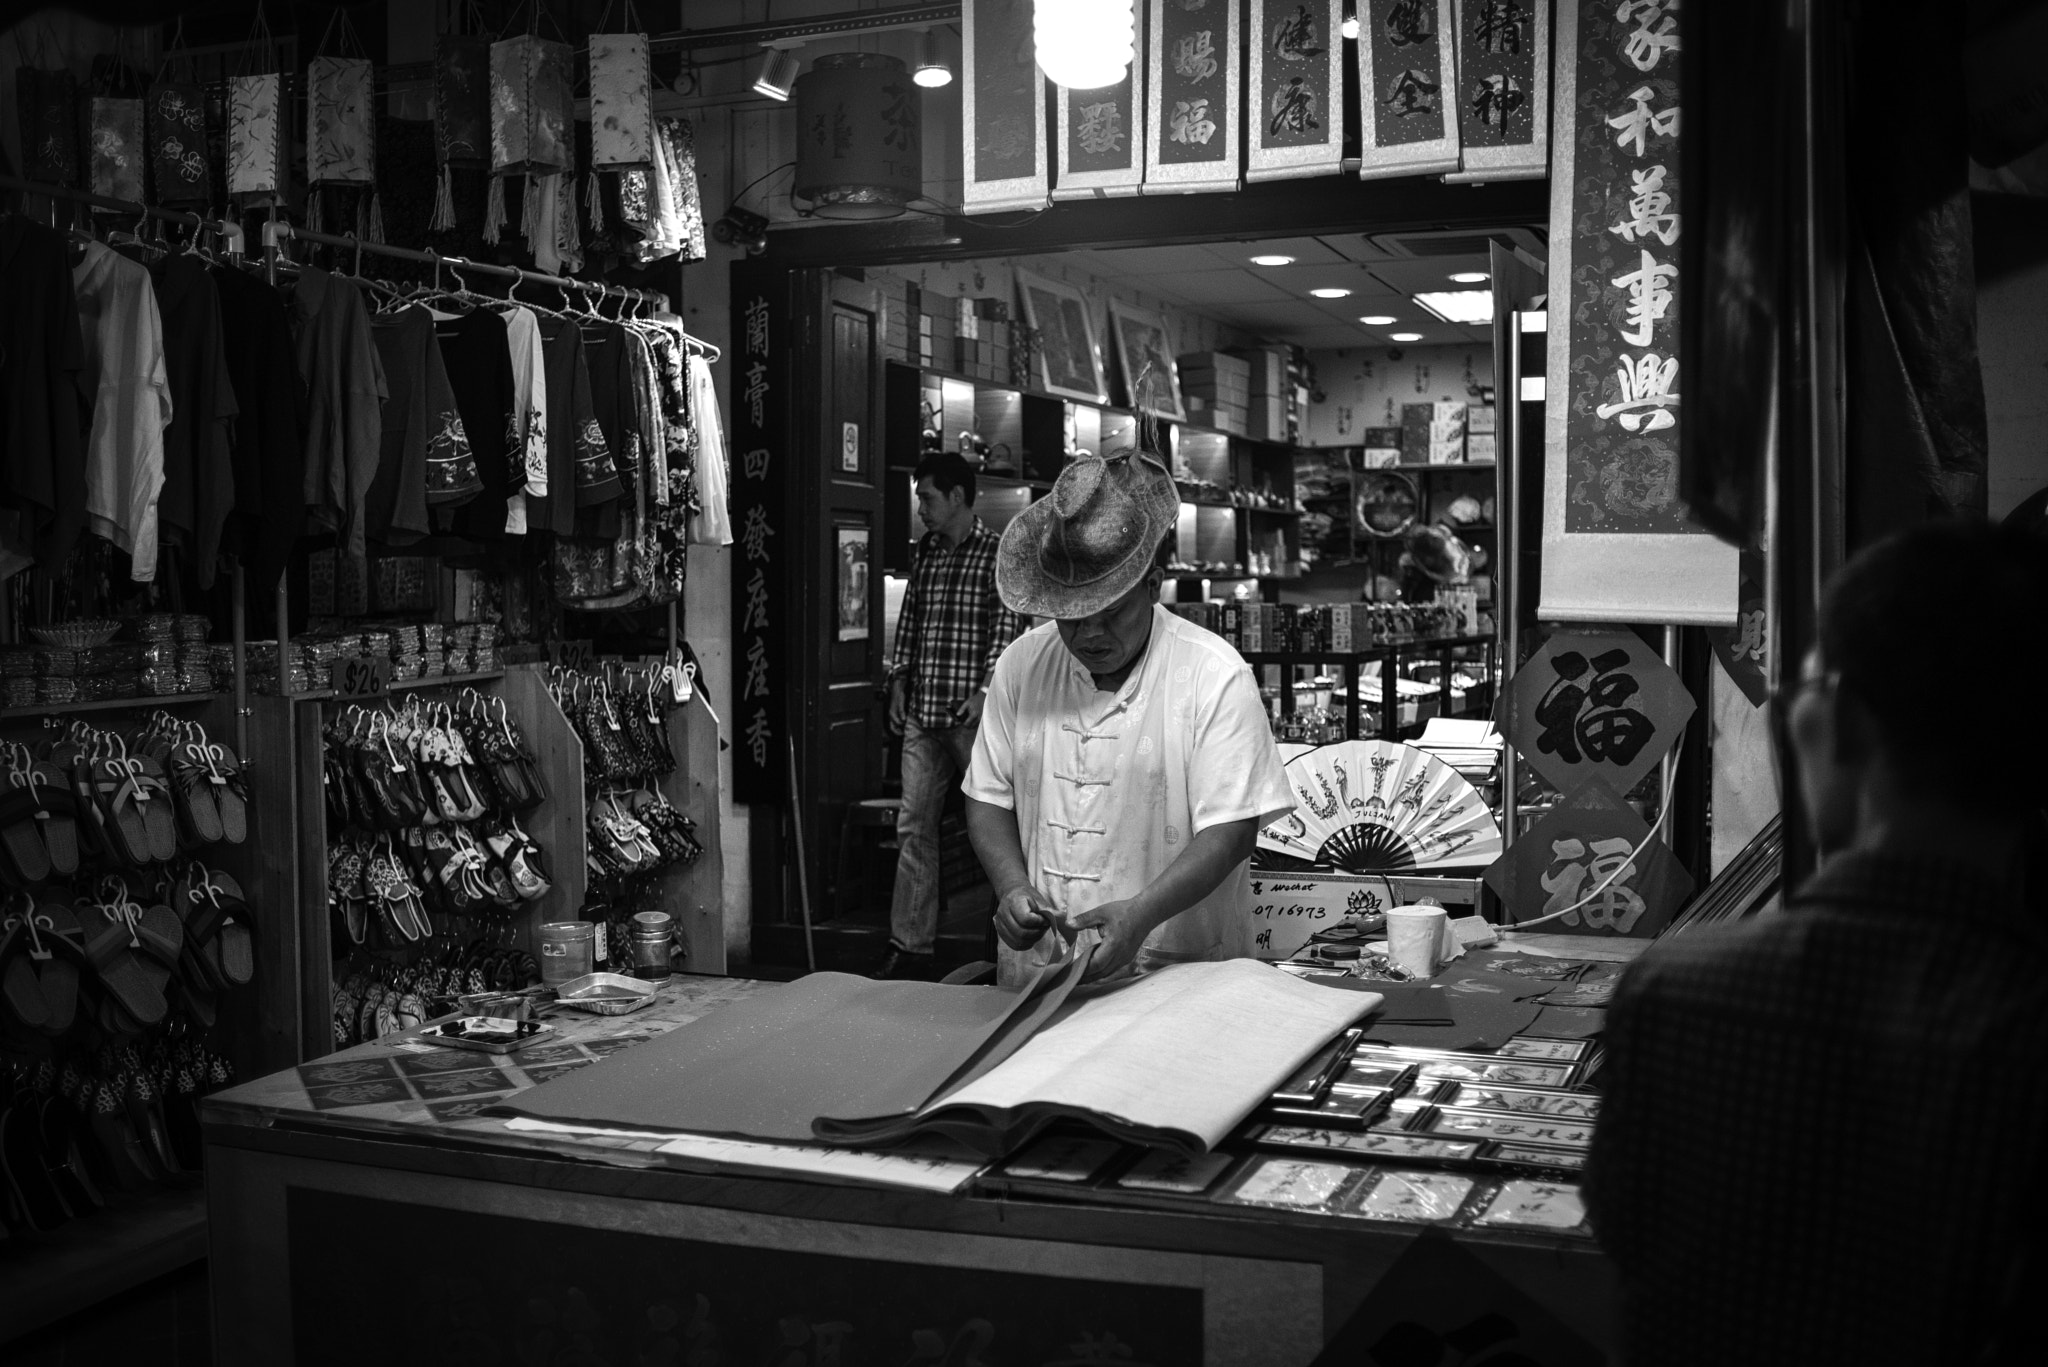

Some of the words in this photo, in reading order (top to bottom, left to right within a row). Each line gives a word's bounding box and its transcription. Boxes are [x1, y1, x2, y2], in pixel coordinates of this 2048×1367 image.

[1170, 0, 1218, 145] 賜福
[1270, 5, 1326, 136] 健康
[1472, 0, 1528, 138] 精神
[1597, 0, 1683, 435] 家和萬事興
[344, 661, 380, 695] $26
[559, 643, 589, 671] $26
[1535, 648, 1656, 766] 福
[1353, 810, 1397, 824] JULIANA
[1541, 836, 1647, 934] 福
